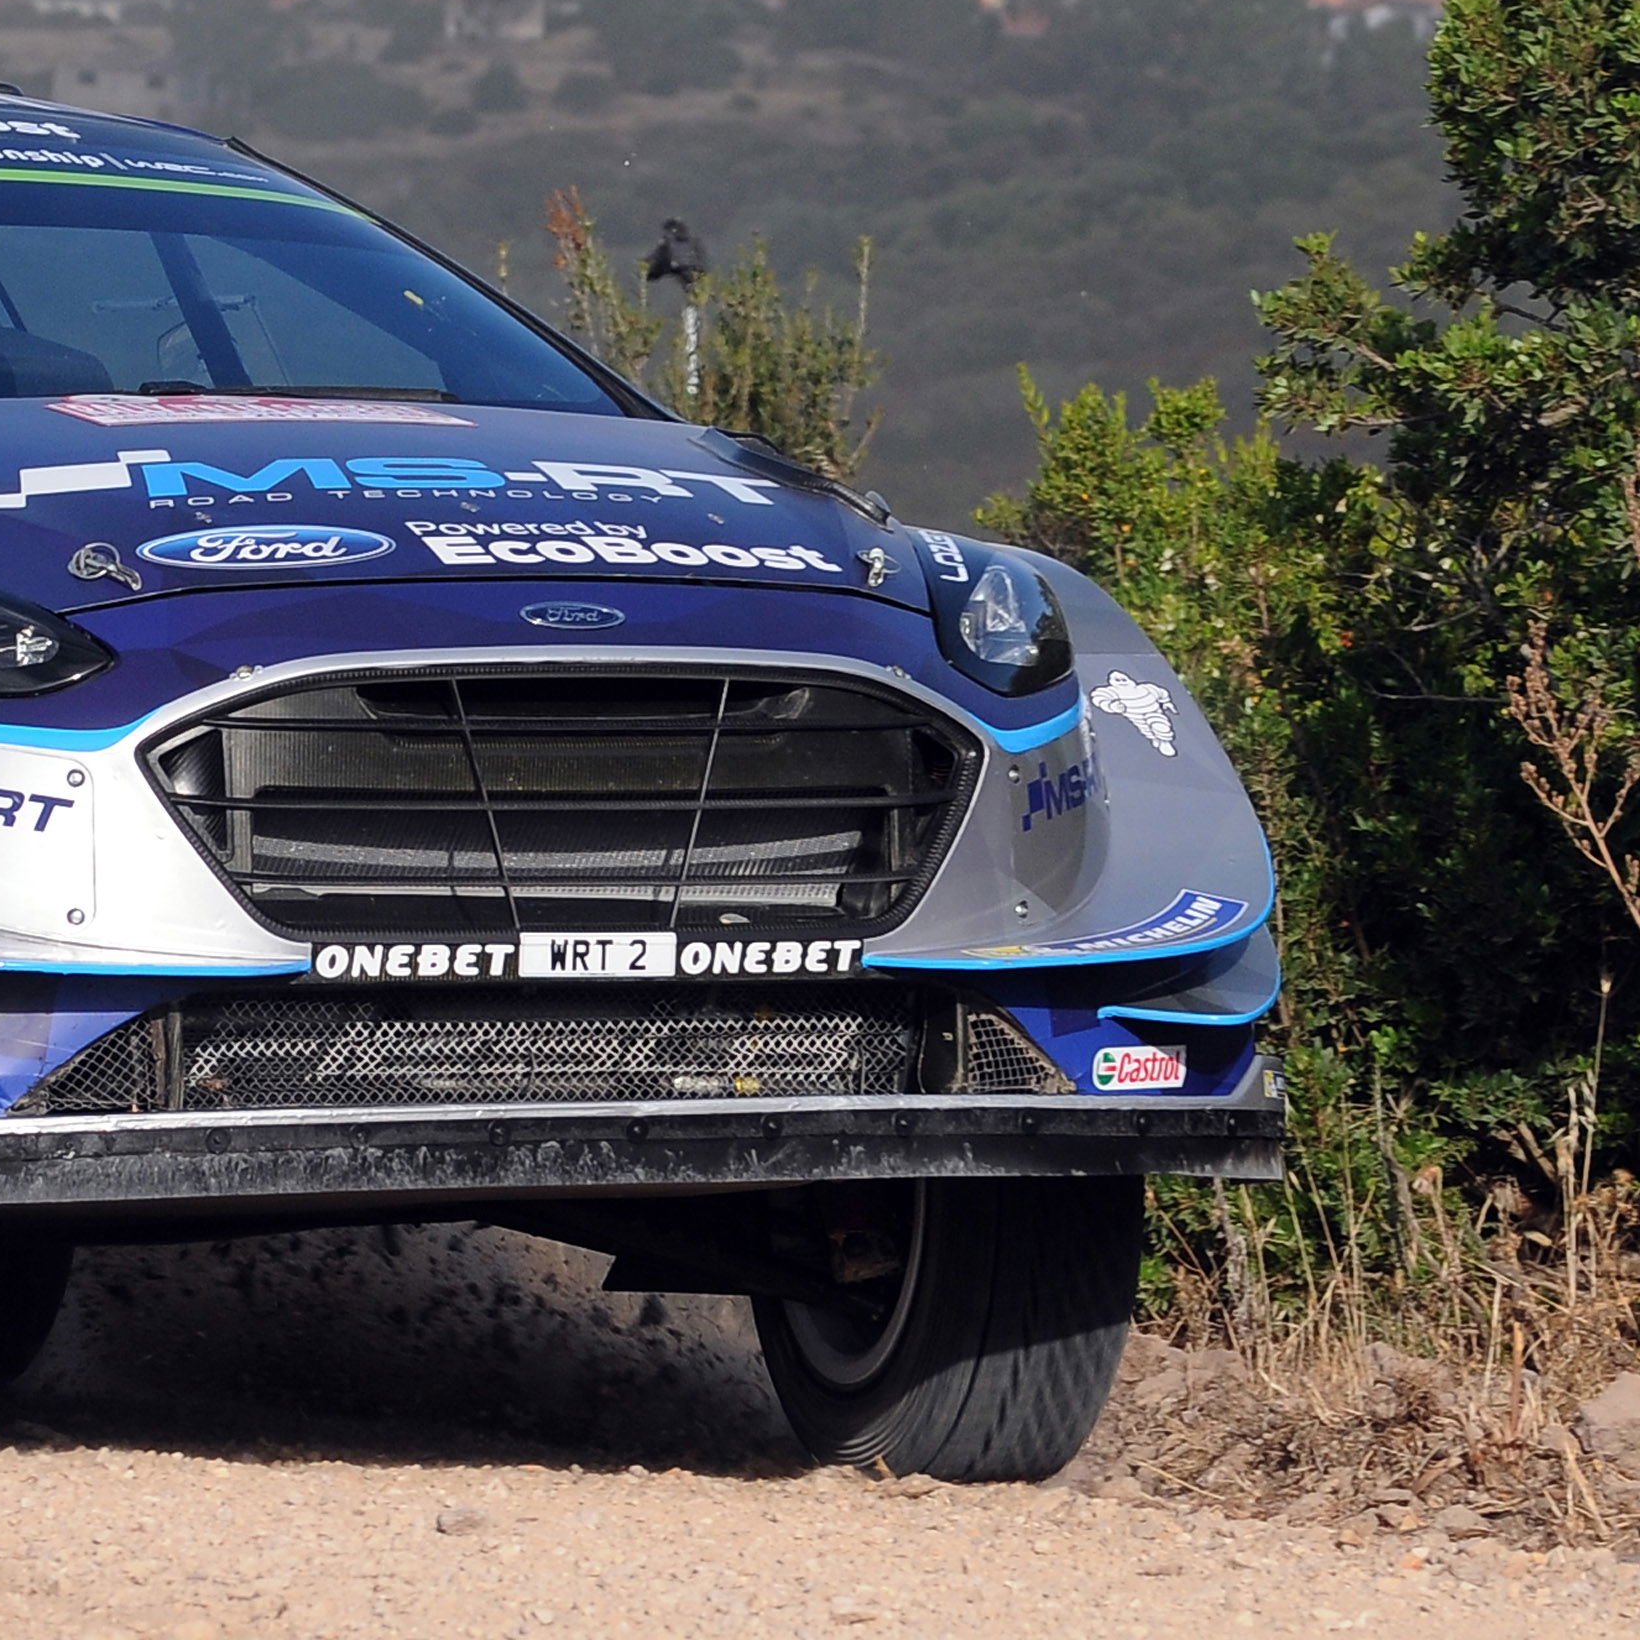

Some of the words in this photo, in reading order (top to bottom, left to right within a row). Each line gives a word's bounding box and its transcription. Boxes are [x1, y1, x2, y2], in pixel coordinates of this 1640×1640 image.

[142, 458, 781, 505] MS-RT
[150, 492, 294, 509] ROAD
[328, 488, 664, 504] TECHNOLOGY
[190, 531, 347, 561] Ford
[405, 520, 595, 537] Powered
[594, 520, 648, 539] by
[422, 536, 843, 572] EcoBoost
[315, 943, 515, 979] ONEBET
[549, 939, 616, 972] WRT
[628, 938, 648, 972] 2
[680, 940, 861, 975] ONEBET
[1117, 1051, 1181, 1083] Castrol
